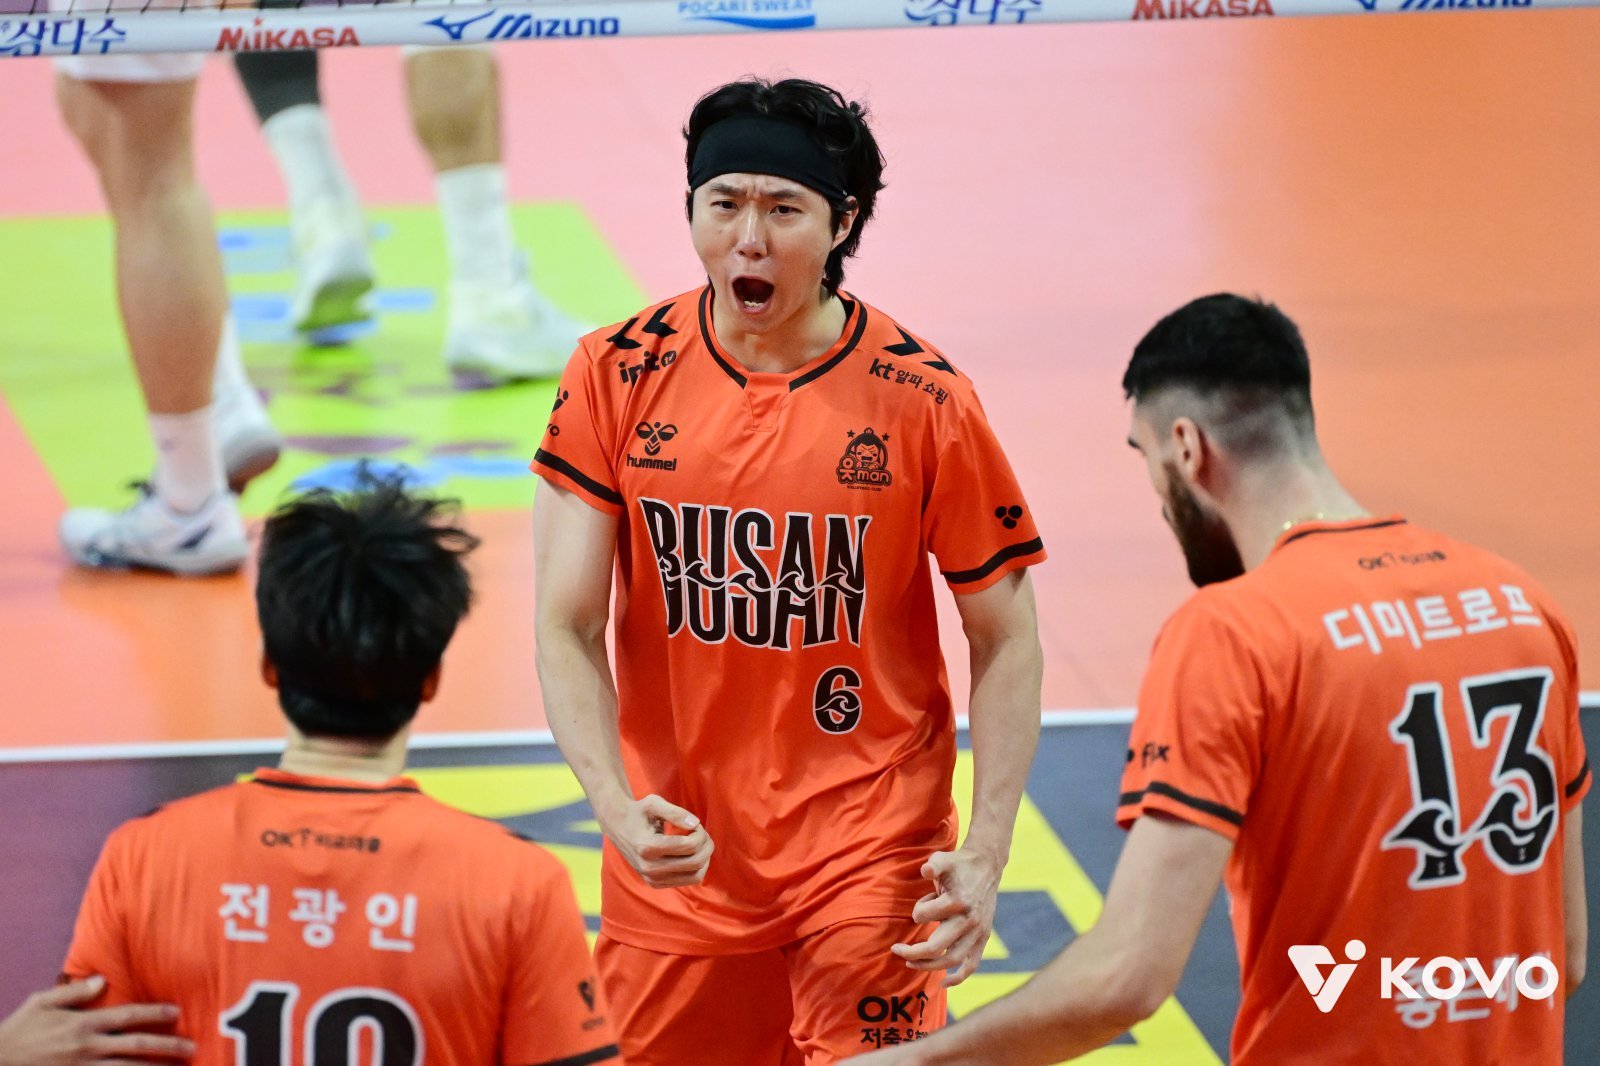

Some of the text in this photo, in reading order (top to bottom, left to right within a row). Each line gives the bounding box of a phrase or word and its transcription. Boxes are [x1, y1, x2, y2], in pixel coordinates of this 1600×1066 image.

[678, 0, 746, 13] POCARI
[1131, 0, 1275, 20] MIKASA
[4, 18, 126, 56] 삼다수
[215, 17, 361, 51] MIKASA
[868, 358, 894, 380] kt
[626, 454, 677, 471] hummel
[637, 496, 873, 651] BUSAN
[1323, 583, 1543, 655] 디미트로프
[812, 664, 862, 735] 6
[1381, 666, 1561, 891] 13
